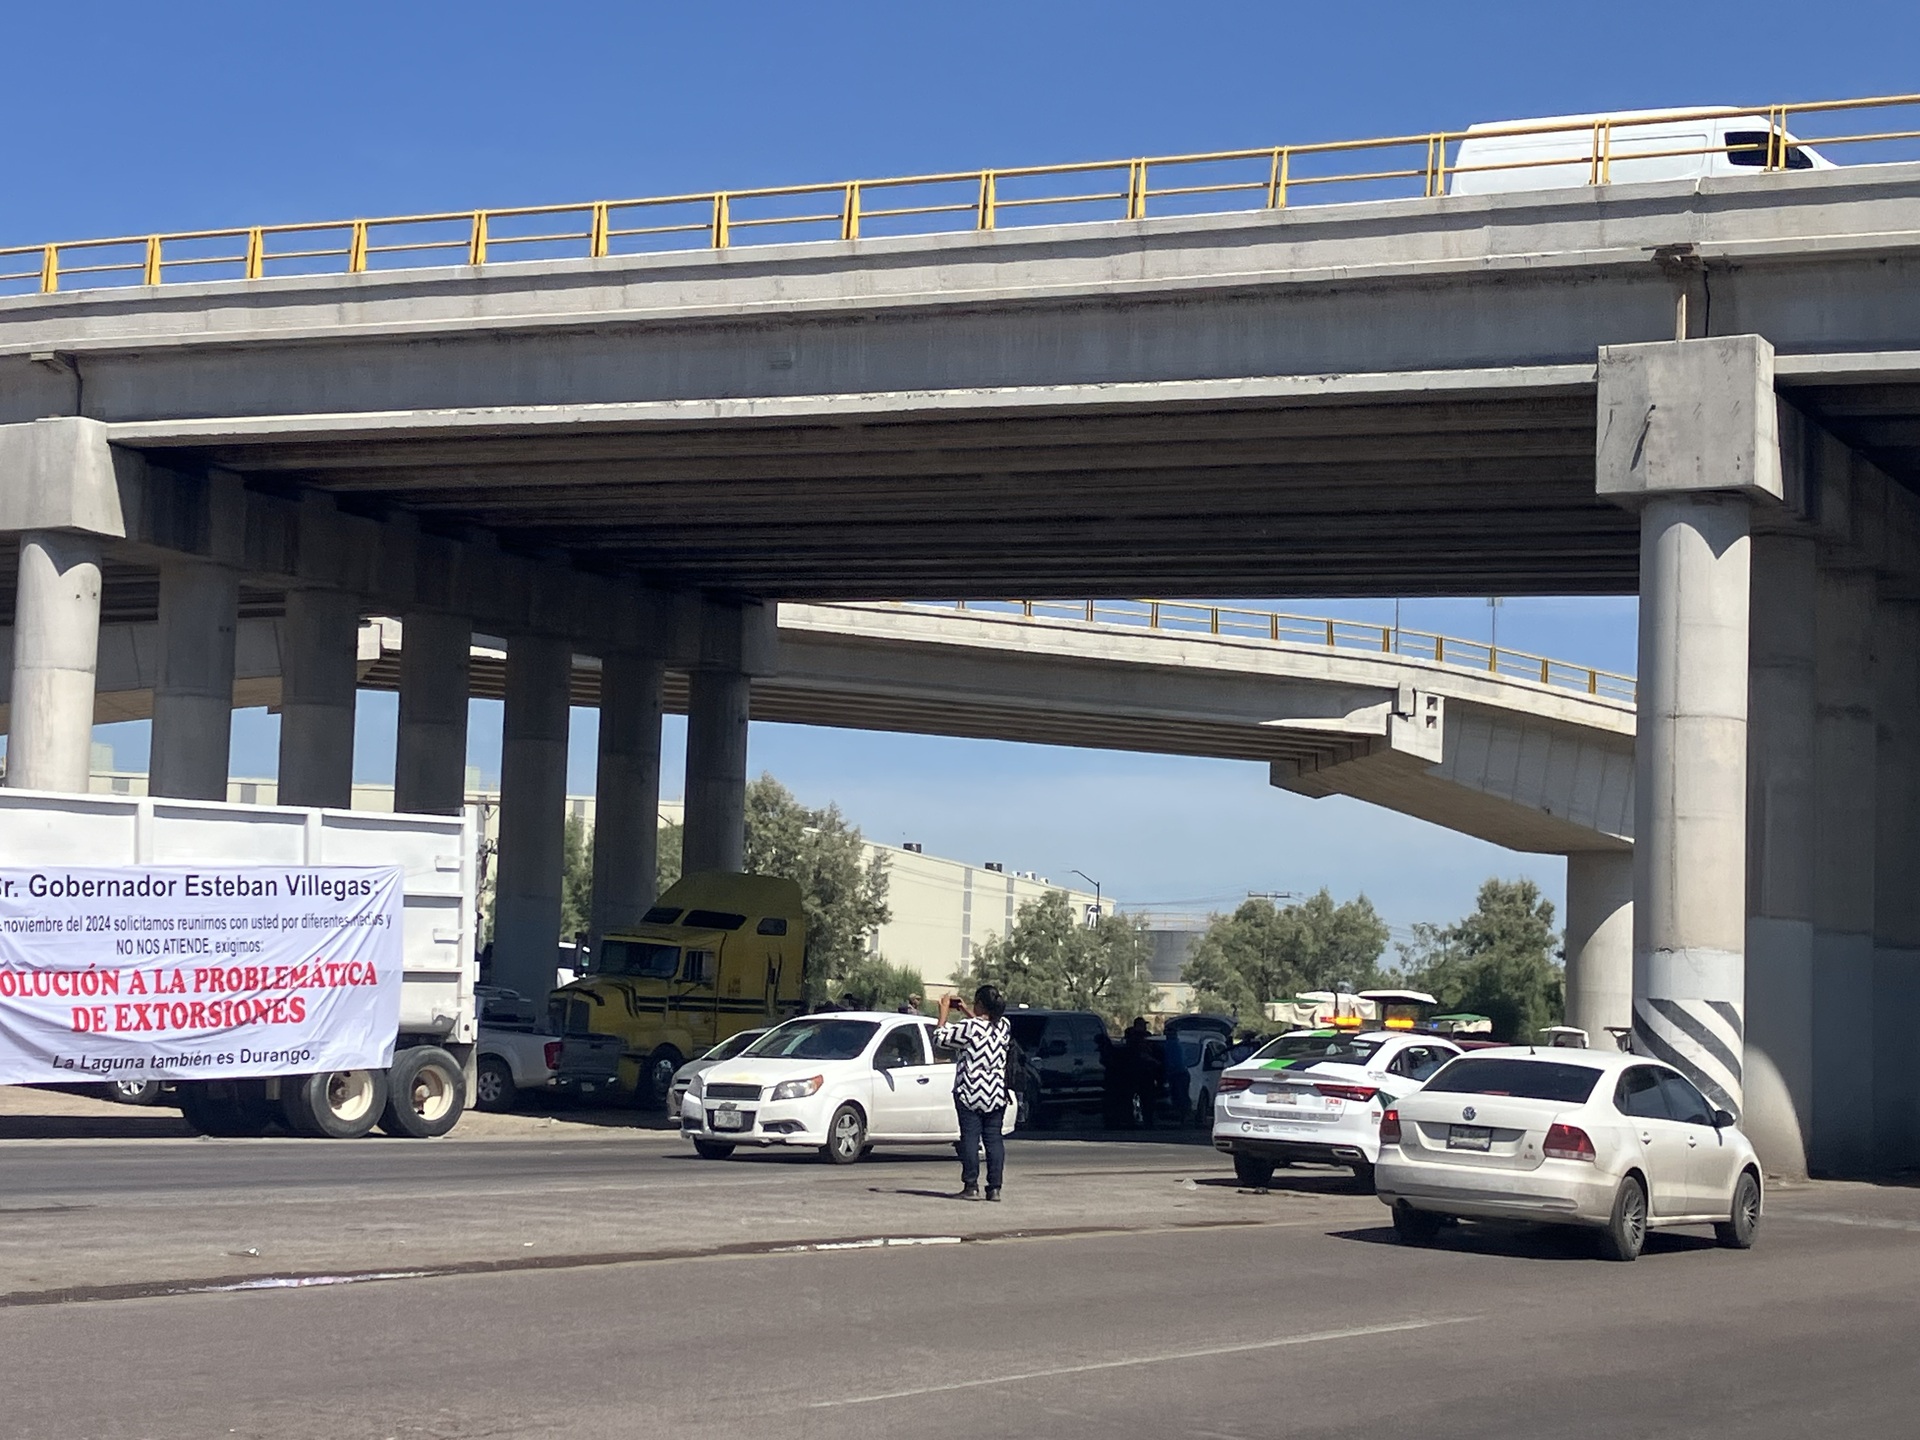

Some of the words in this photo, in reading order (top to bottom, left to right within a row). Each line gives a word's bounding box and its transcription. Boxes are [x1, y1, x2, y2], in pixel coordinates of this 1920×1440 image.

[0, 877, 19, 897] r.
[29, 874, 177, 897] Gobernador
[185, 875, 278, 897] Esteban
[285, 874, 379, 901] Villegas:
[3, 916, 63, 933] noviembre
[66, 915, 83, 932] del
[85, 915, 111, 932] 2024
[114, 914, 175, 931] solicitamos
[178, 914, 226, 931] reunirnos
[230, 917, 249, 930] con
[251, 914, 279, 930] usted
[282, 917, 299, 933] por
[301, 912, 349, 929] diferentes
[386, 914, 392, 930] y
[116, 938, 134, 955] NO
[137, 938, 160, 955] NOS
[163, 937, 213, 956] ATIENDE,
[215, 937, 265, 957] exigimos:
[127, 969, 148, 995] A
[154, 968, 188, 994] LA
[193, 957, 378, 993] PROBLEMÁTICA
[71, 1005, 108, 1032] DE
[115, 996, 306, 1032] EXTORSIONES
[52, 1055, 75, 1069] La
[80, 1054, 145, 1073] Laguna
[150, 1049, 212, 1069] también
[217, 1054, 235, 1065] es
[240, 1048, 316, 1065] Durango.
